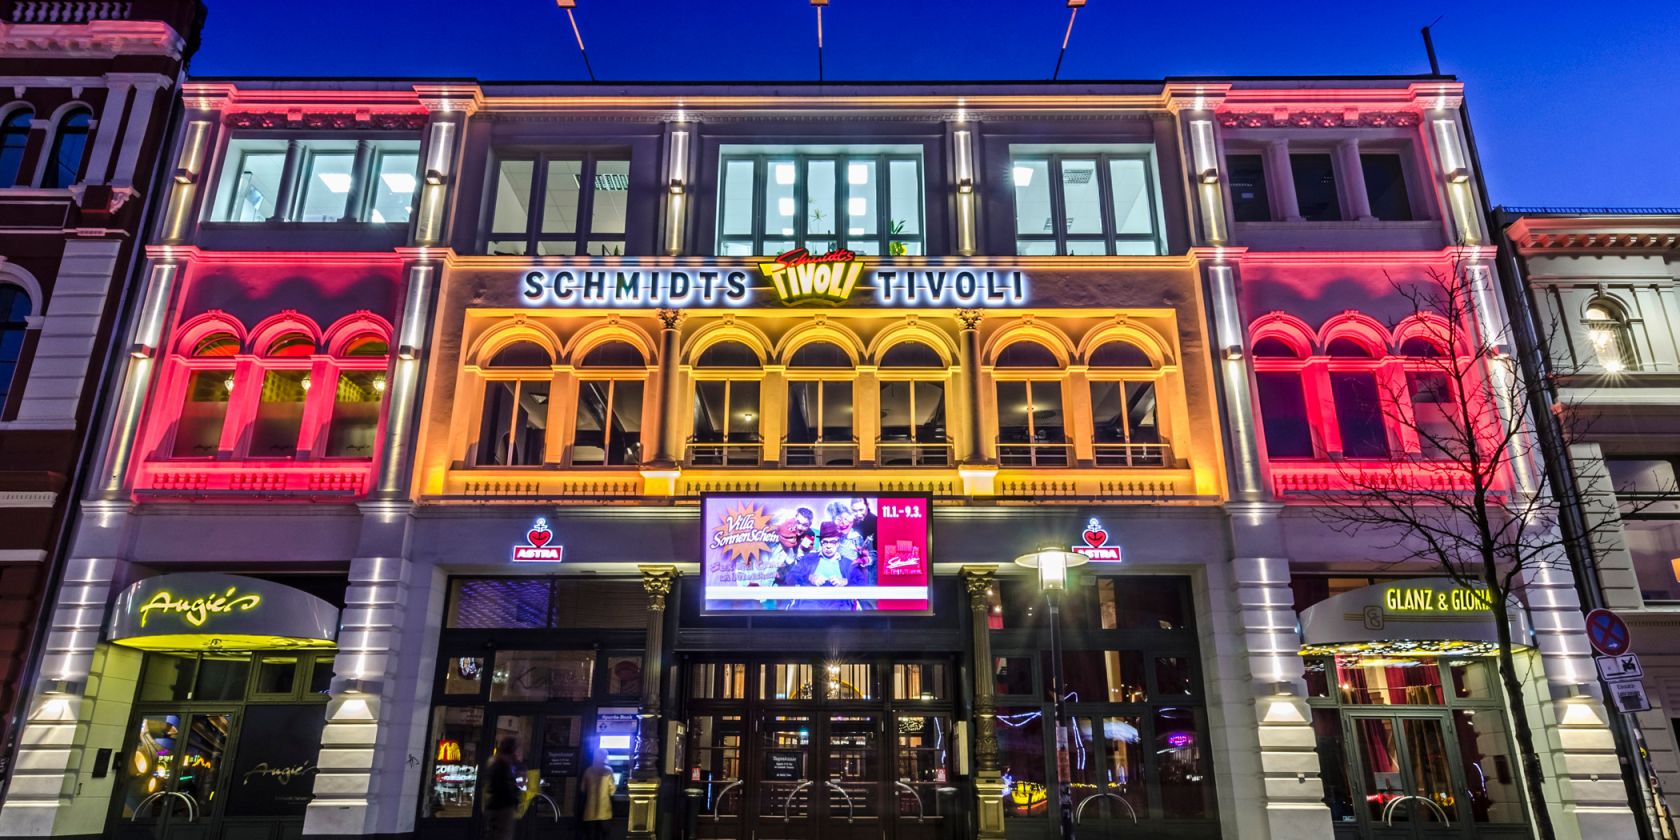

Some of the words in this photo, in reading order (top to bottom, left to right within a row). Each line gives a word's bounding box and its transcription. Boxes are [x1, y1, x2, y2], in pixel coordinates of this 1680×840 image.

[772, 248, 855, 271] Schmidts
[524, 271, 746, 300] SCHMIDTS
[759, 262, 865, 299] TIVOLI
[878, 271, 1022, 300] TIVOLI
[727, 514, 755, 532] Villa
[516, 549, 559, 558] ASTRA
[1387, 588, 1433, 610] GLANZ
[1438, 593, 1448, 611] &
